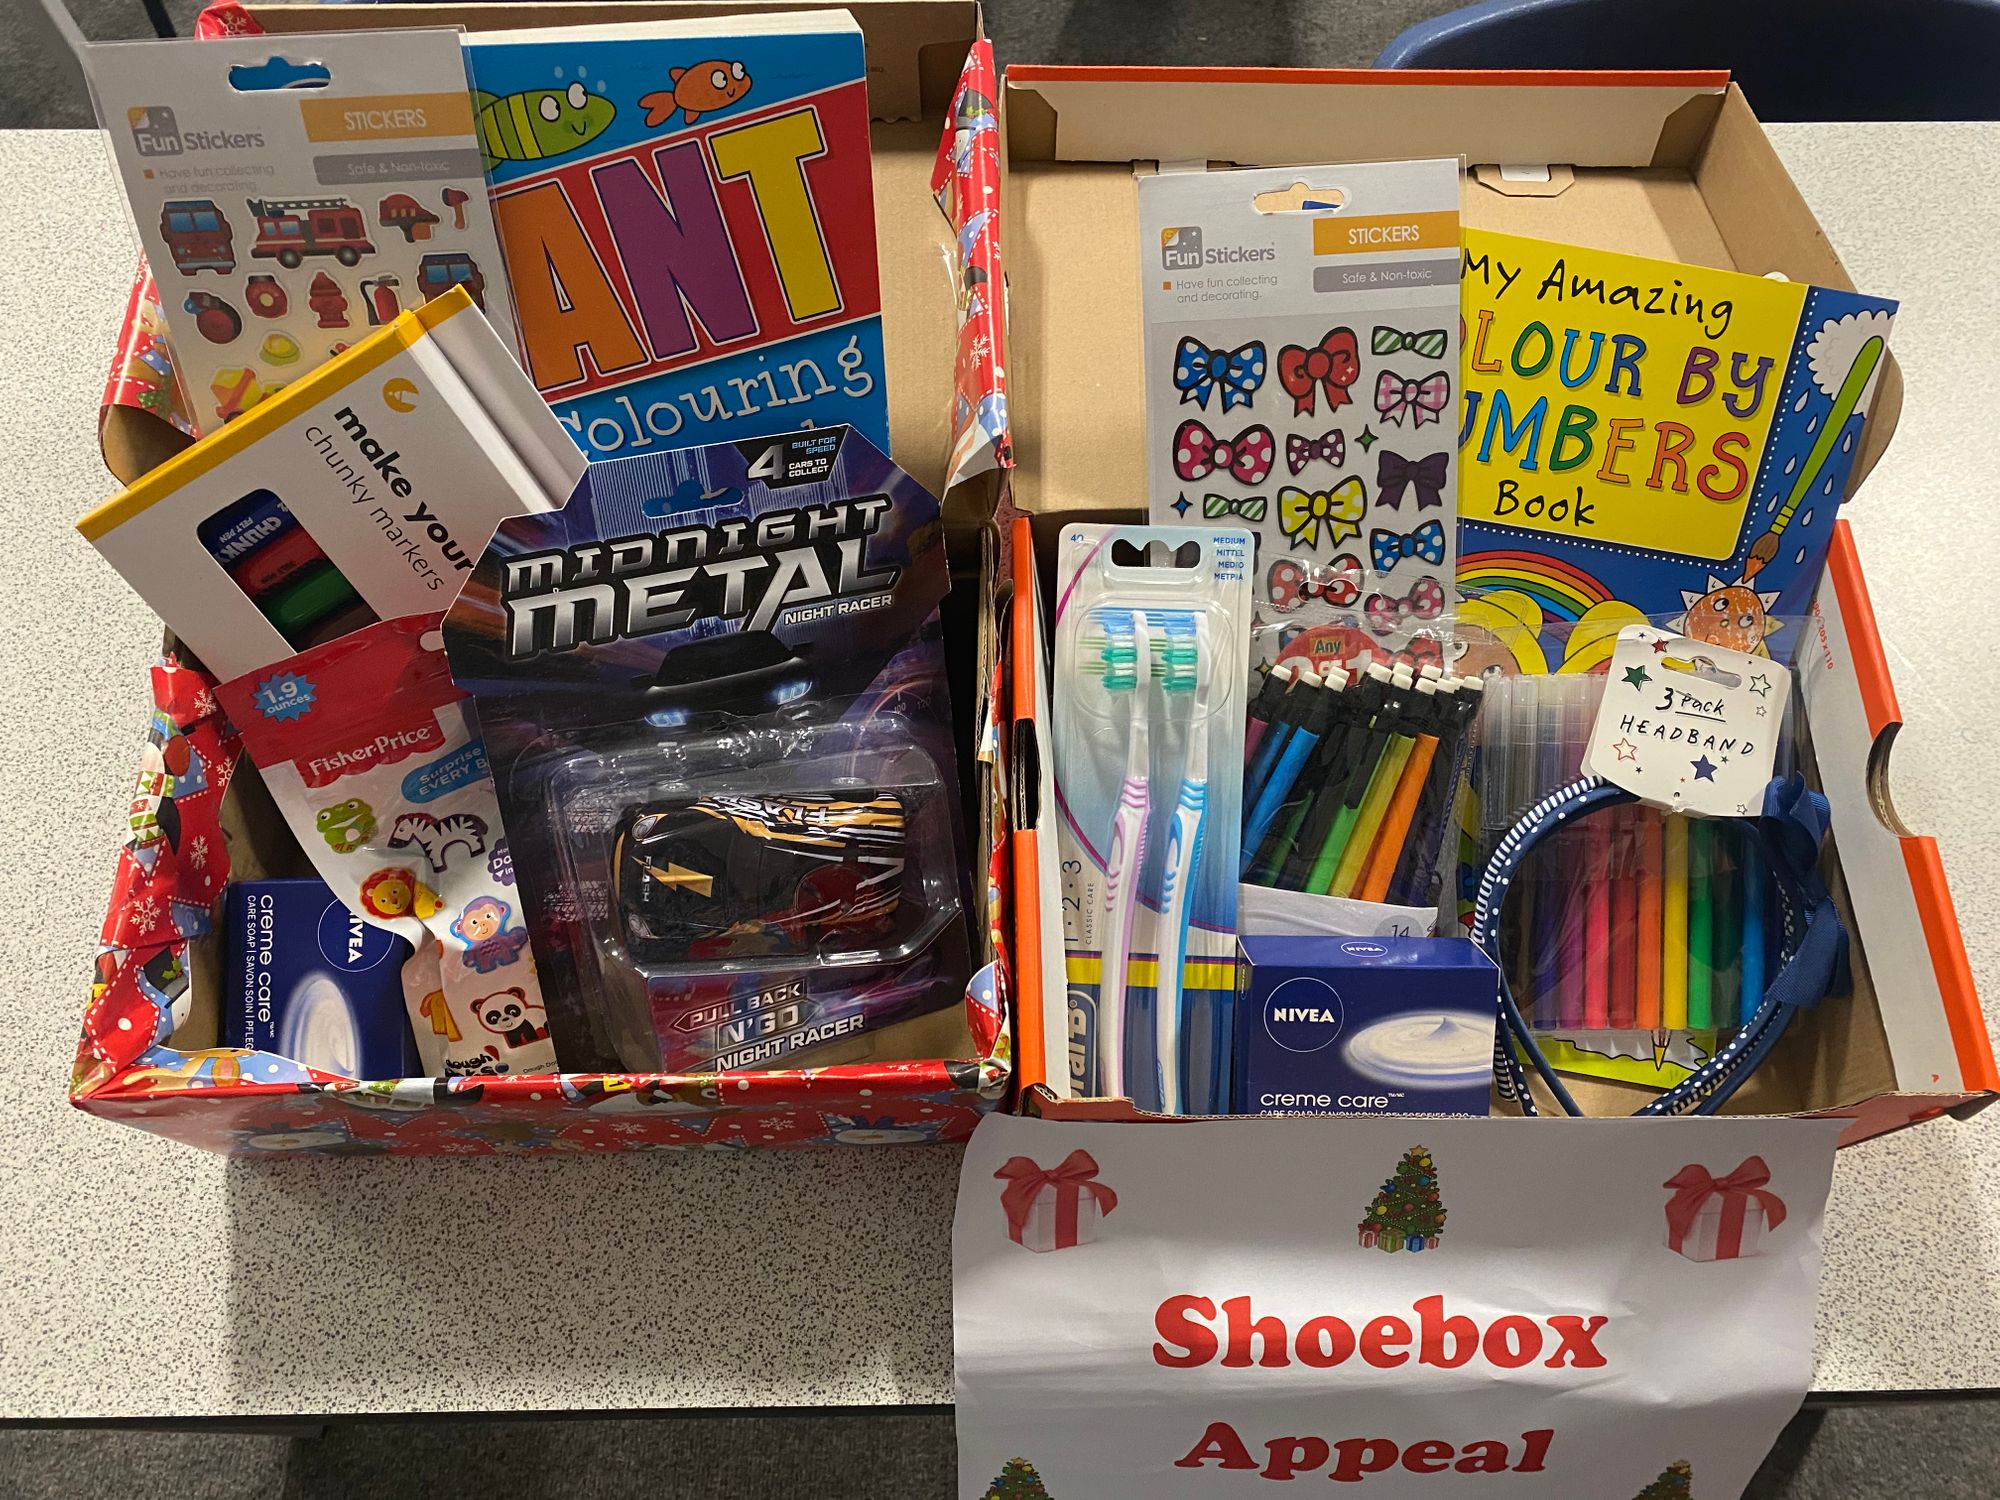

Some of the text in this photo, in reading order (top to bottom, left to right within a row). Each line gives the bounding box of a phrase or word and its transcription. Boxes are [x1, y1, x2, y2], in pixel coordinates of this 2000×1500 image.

[344, 108, 426, 131] STICKERS
[137, 130, 265, 152] Fun Stickers
[159, 164, 274, 179] Have fun collecting
[347, 160, 450, 176] Safe & Non-toxic
[1348, 225, 1420, 245] STICKERS
[1165, 243, 1275, 267] Fun Stickers
[1176, 274, 1278, 290] Have fun collecting
[1342, 268, 1432, 284] Safe & Non-toxic
[1177, 291, 1199, 304] and
[1461, 248, 1734, 340] My Amazing
[1460, 309, 1648, 397] LOUR
[792, 436, 837, 449] BUILT FOR
[805, 444, 836, 455] SPEED
[748, 443, 786, 480] 4
[789, 458, 827, 470] CARS TO
[789, 465, 830, 478] COLLECT
[334, 406, 475, 571] make your
[305, 426, 445, 591] chunky markers
[1493, 479, 1596, 527] Book
[505, 498, 892, 593] MIDNIGHT
[1213, 536, 1246, 545] MEDIUM
[1216, 549, 1245, 557] MITTEL
[1218, 561, 1244, 569] MEDIO
[507, 539, 898, 657] METAL
[784, 594, 893, 625] NIGHT RACER
[1315, 639, 1341, 655] Any
[263, 681, 299, 704] 1.9
[266, 692, 311, 714] ounces
[1655, 687, 1725, 716] 3 Pack
[1620, 714, 1755, 756] HEADBAND
[308, 729, 432, 777] Fisher-Price
[419, 747, 482, 785] Surprise
[419, 764, 470, 796] EVERY
[641, 855, 652, 902] FLASH
[247, 895, 257, 920] CARE
[1085, 882, 1095, 945] CLASSIC CARE
[246, 922, 256, 948] SOAP
[259, 894, 274, 966] creme
[348, 911, 364, 964] IVEA
[245, 955, 256, 988] SAVON
[245, 990, 255, 1014] SOIN
[258, 971, 272, 1023] care
[689, 982, 801, 1028] PULL BACK
[1273, 1007, 1335, 1023] NIVEA
[716, 1013, 865, 1072] NIGHT RACER
[1260, 1093, 1331, 1107] creme
[1338, 1095, 1389, 1108] care
[1153, 1293, 1609, 1370] Shoebox
[1174, 1421, 1557, 1483] Appeal
